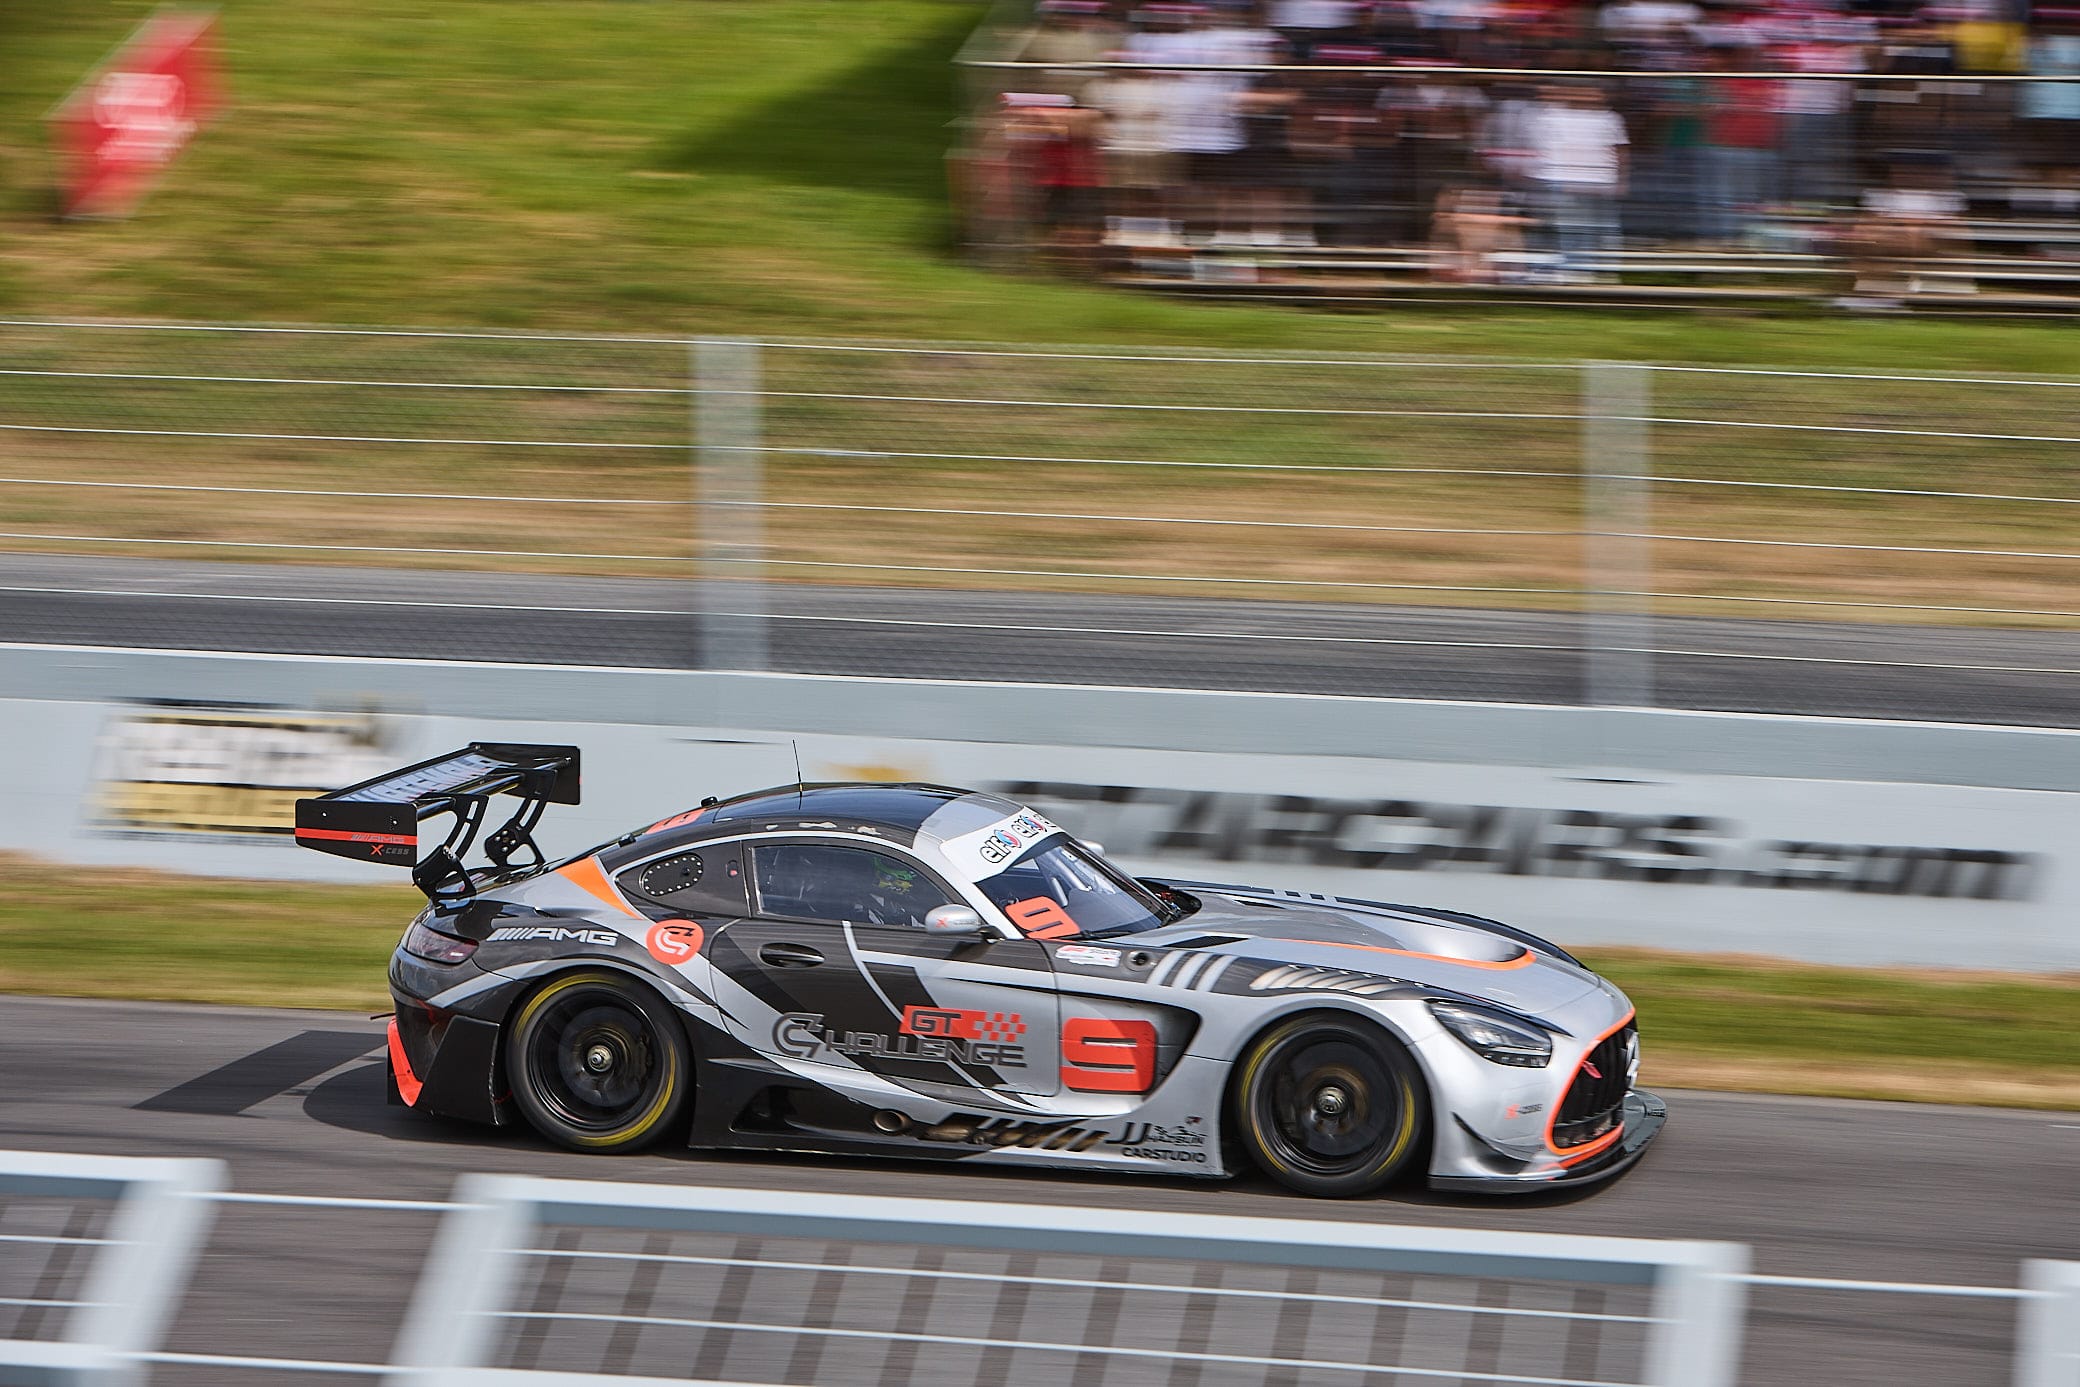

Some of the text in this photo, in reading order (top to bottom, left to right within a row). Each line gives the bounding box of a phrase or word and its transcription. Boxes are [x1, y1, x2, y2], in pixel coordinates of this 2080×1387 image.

[980, 833, 1014, 863] elf
[1004, 896, 1081, 940] 9
[525, 927, 620, 946] AMG
[910, 1009, 962, 1034] GT
[771, 1011, 1028, 1068] CHALLENGE
[1060, 1017, 1157, 1093] 9
[1121, 1146, 1207, 1163] CARSTUDIO
